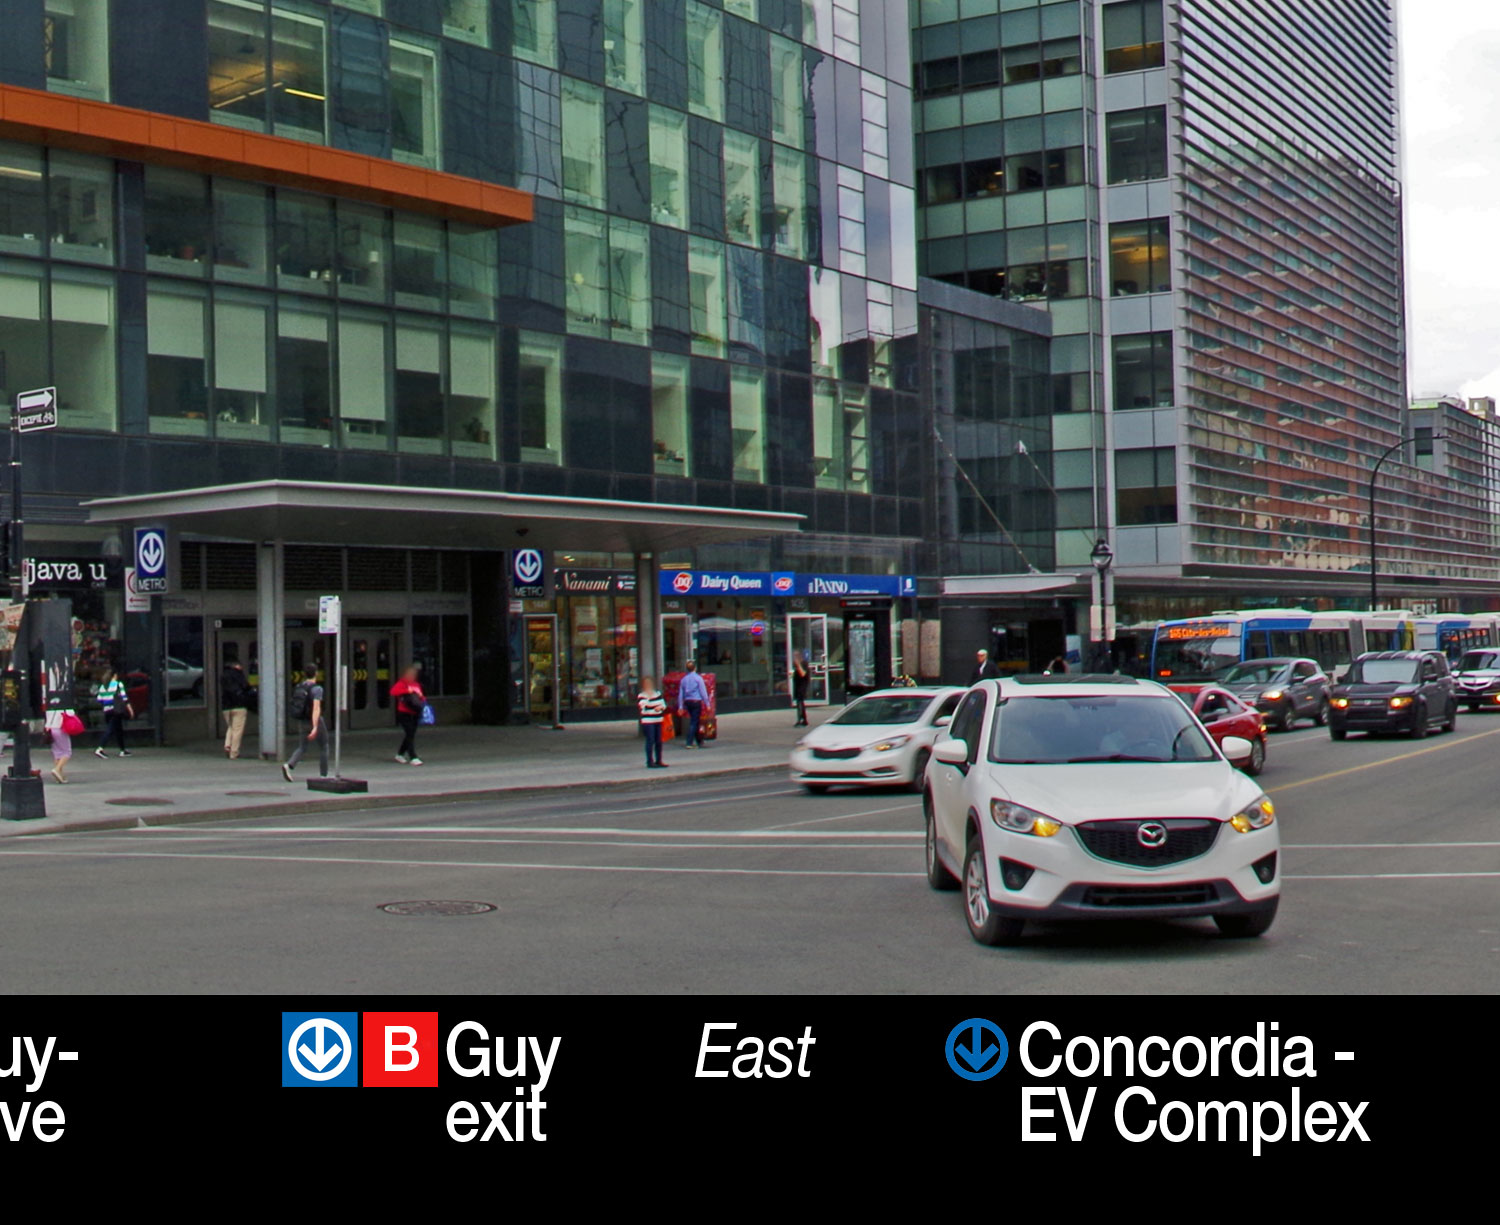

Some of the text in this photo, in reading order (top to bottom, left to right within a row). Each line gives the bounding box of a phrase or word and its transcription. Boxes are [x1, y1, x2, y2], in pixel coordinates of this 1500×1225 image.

[28, 558, 107, 586] java u
[553, 568, 612, 591] Nanami
[138, 579, 167, 591] METRO
[514, 587, 544, 596] METRO
[701, 574, 729, 592] Dairy
[730, 575, 762, 590] Queen
